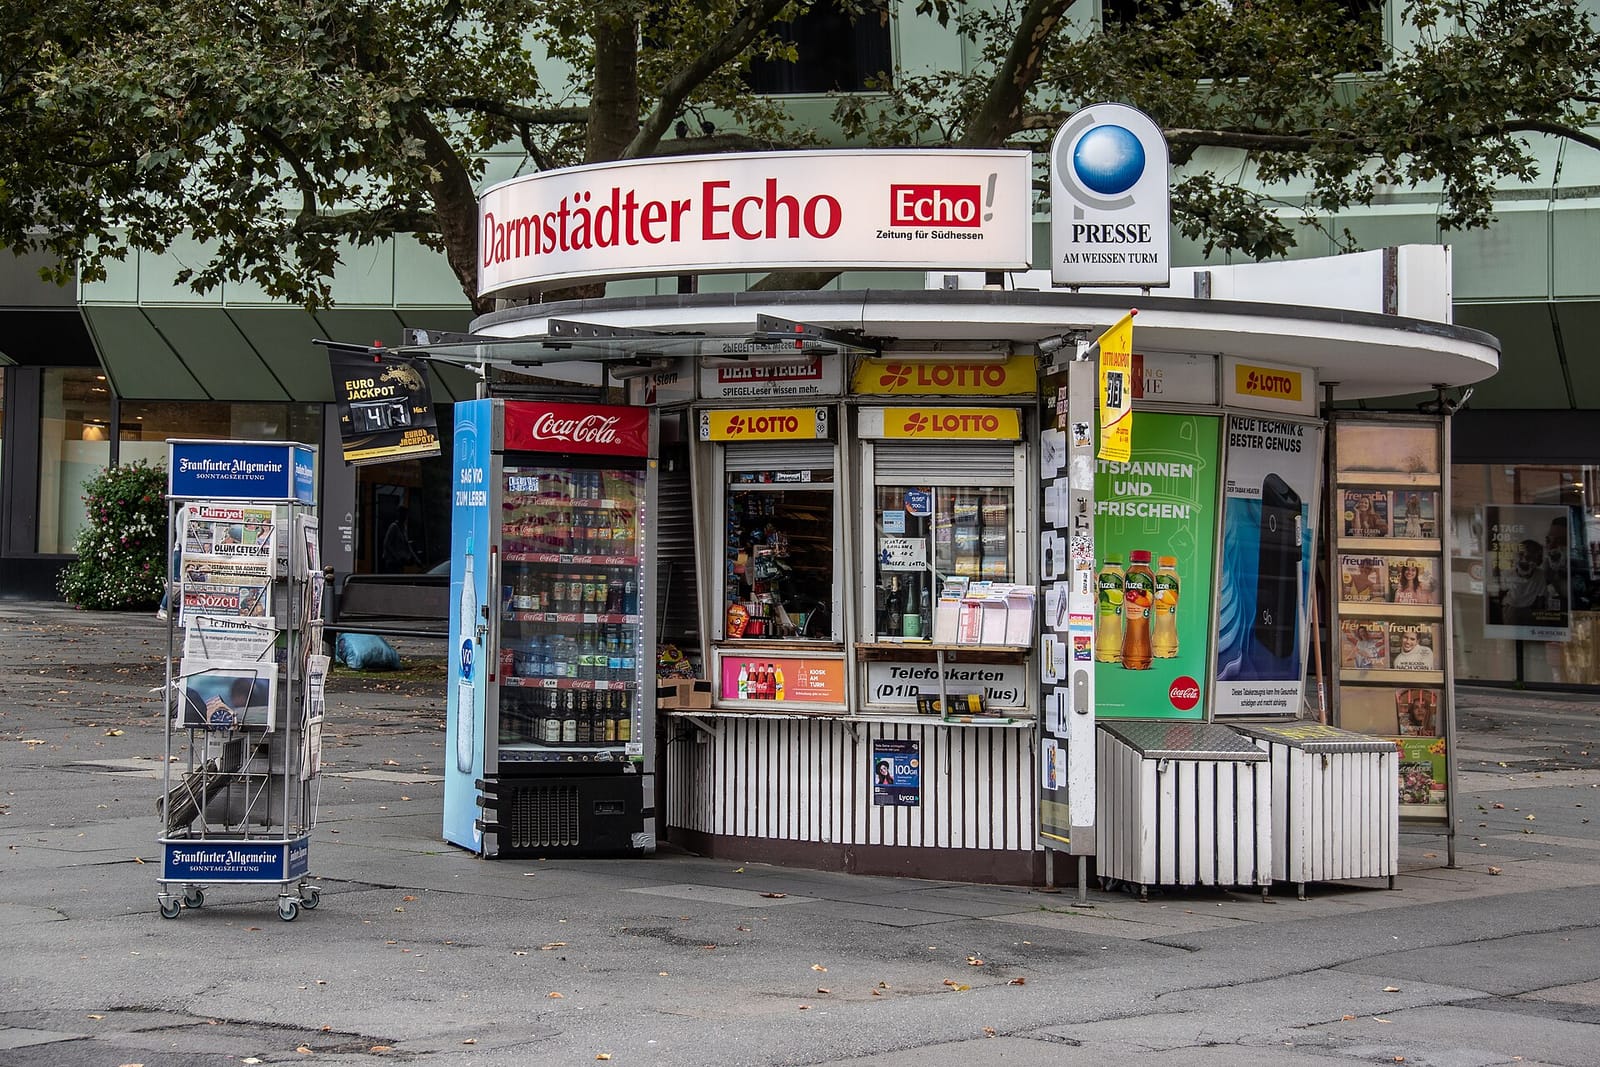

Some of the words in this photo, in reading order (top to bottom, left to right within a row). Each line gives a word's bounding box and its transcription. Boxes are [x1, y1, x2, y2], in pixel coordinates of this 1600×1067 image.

[482, 187, 692, 269] Darmstädter
[701, 178, 844, 242] Echo
[876, 229, 912, 243] Zeitung
[915, 229, 928, 241] für
[931, 229, 984, 241] Südhessen
[1072, 223, 1152, 245] PRESSE
[1063, 253, 1079, 264] AM
[1081, 253, 1124, 265] WEISSEN
[1127, 253, 1159, 265] TURM
[657, 372, 678, 386] stern
[918, 364, 1006, 387] LOTTO
[345, 378, 374, 390] EURO
[722, 386, 771, 397] SPIEGEL-Leser
[773, 386, 797, 395] wissen
[799, 385, 819, 394] mehr.
[1260, 374, 1292, 394] LOTTO
[347, 386, 395, 400] JACKPOT
[532, 412, 619, 444] Coca-Cola
[748, 416, 798, 433] LOTTO
[932, 414, 999, 432] LOTTO
[1231, 416, 1256, 431] NEUE
[1257, 419, 1297, 436] TECHNIK
[1297, 427, 1304, 437] &
[1230, 433, 1264, 449] BESTER
[1265, 437, 1302, 453] GENUSS
[179, 457, 232, 473] Frankfurter
[232, 458, 283, 475] Allgemeine
[196, 472, 265, 481] SONNTAGSZEITUNG
[460, 468, 472, 484] SAG
[1114, 481, 1152, 496] UND
[455, 490, 468, 506] ZUM
[468, 490, 487, 507] LEBEN
[1342, 555, 1385, 567] freundin
[1389, 623, 1432, 633] freundin
[890, 667, 1004, 682] Telefonkarten
[1170, 687, 1198, 699] Coca-Cola
[898, 794, 914, 802] Lyca
[172, 849, 225, 865] Frankfurter
[226, 849, 277, 866] Allgemeine
